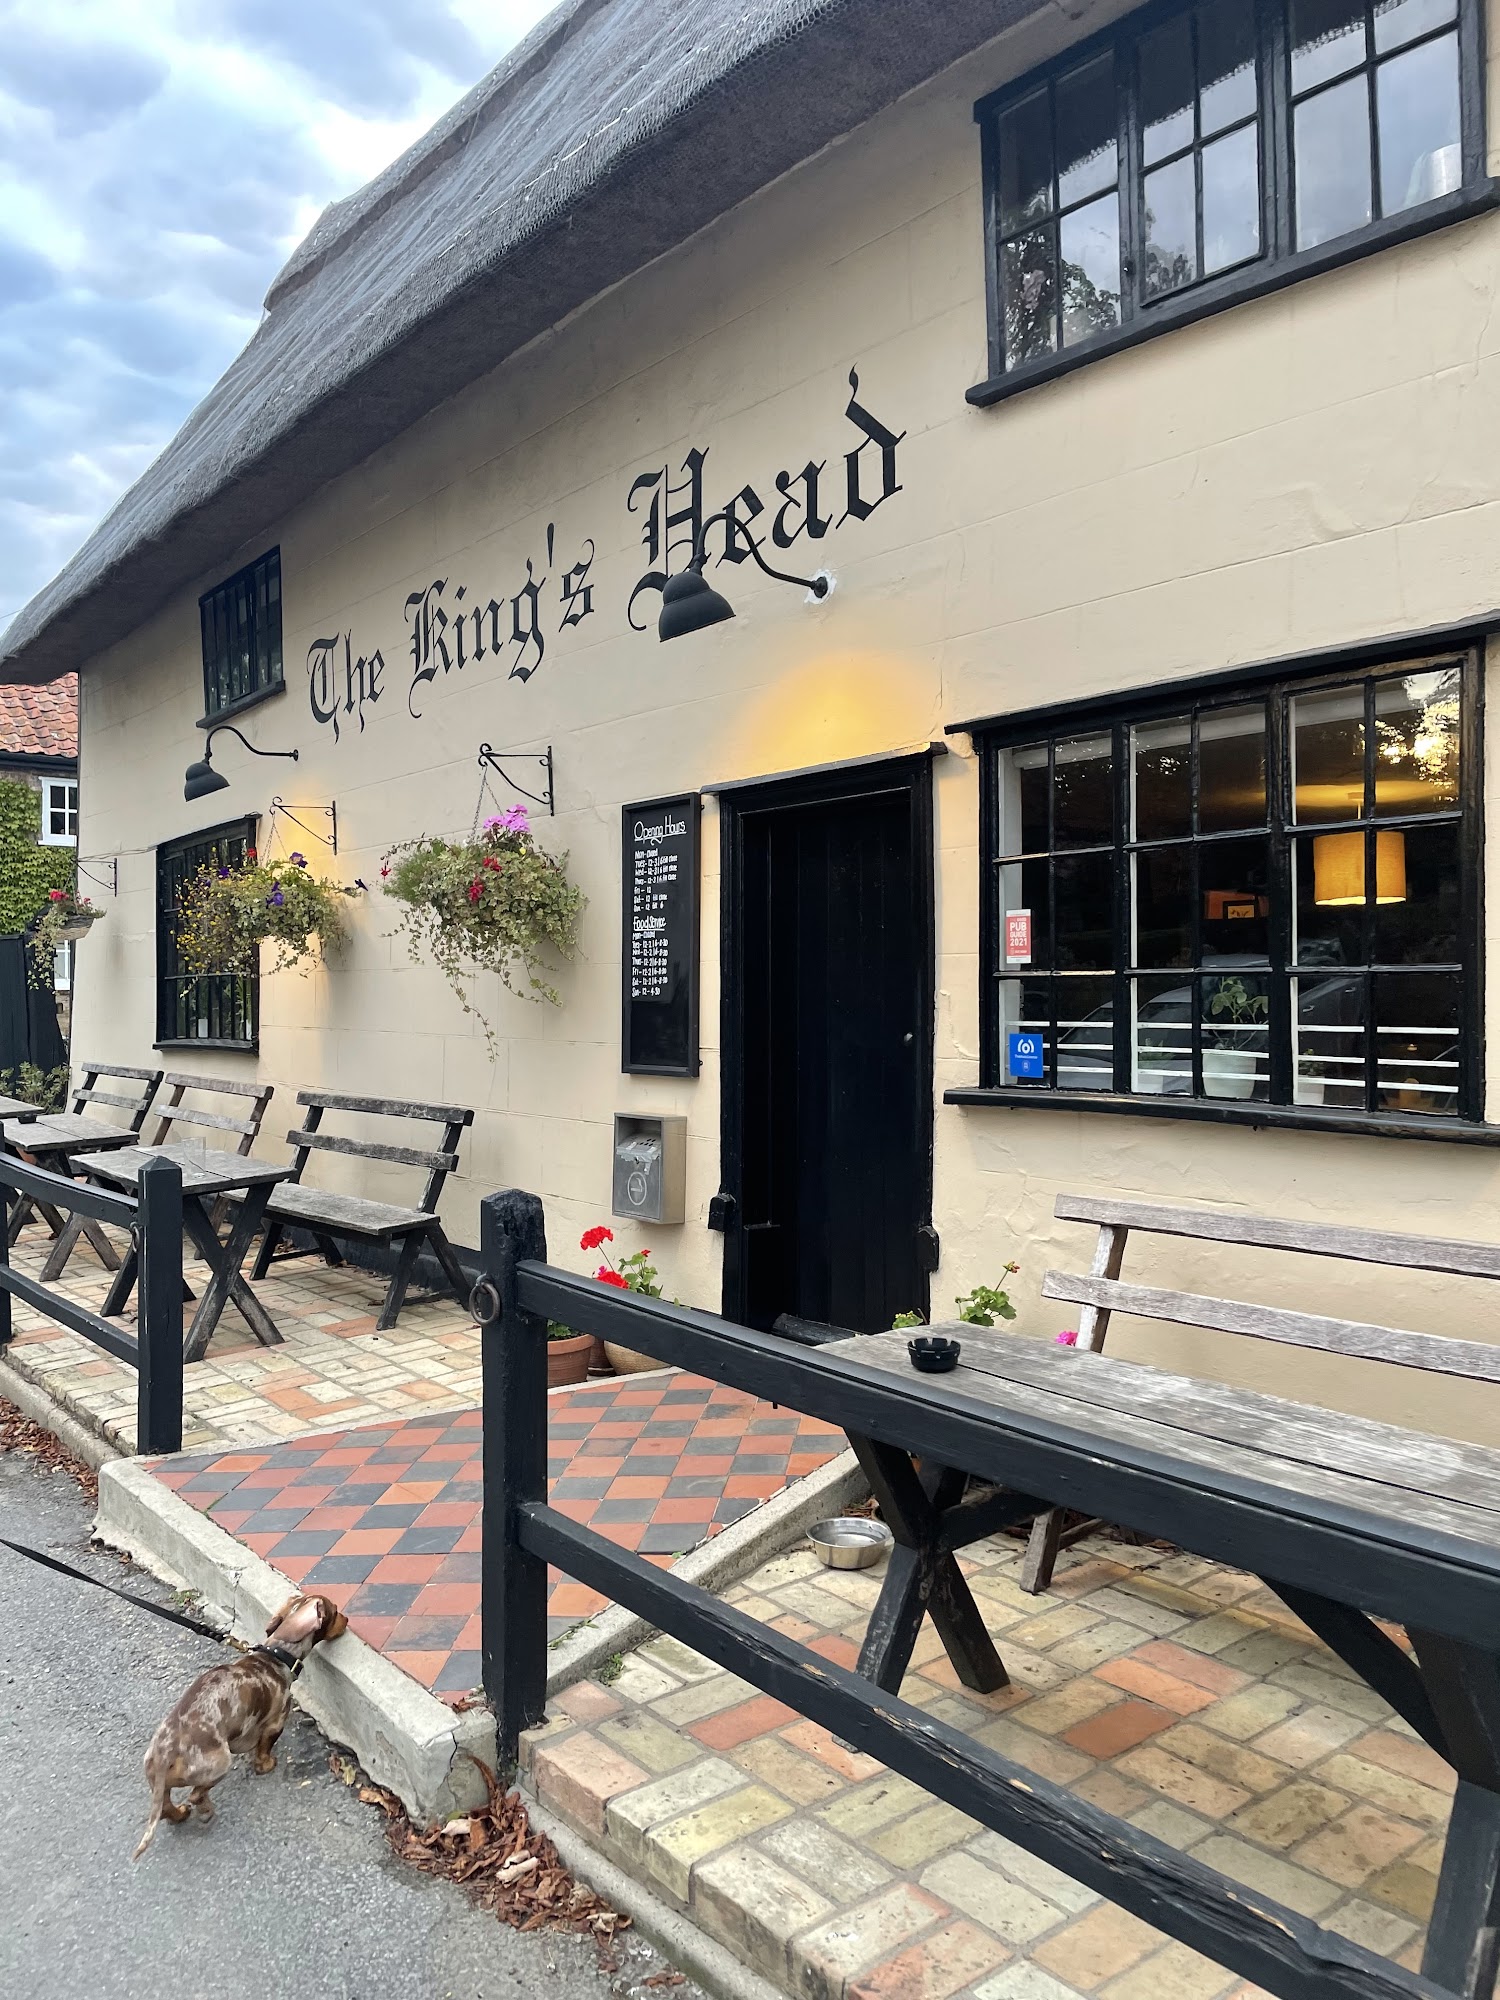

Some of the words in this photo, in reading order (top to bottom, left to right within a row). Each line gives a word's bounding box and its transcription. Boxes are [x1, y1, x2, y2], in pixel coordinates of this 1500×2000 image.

[307, 628, 386, 745] The
[404, 522, 595, 719] King's
[626, 363, 907, 631] Head
[634, 821, 663, 846] Opening
[664, 814, 686, 834] Hours
[633, 915, 649, 930] Food
[1010, 921, 1027, 932] PUB
[1010, 938, 1028, 947] 2021
